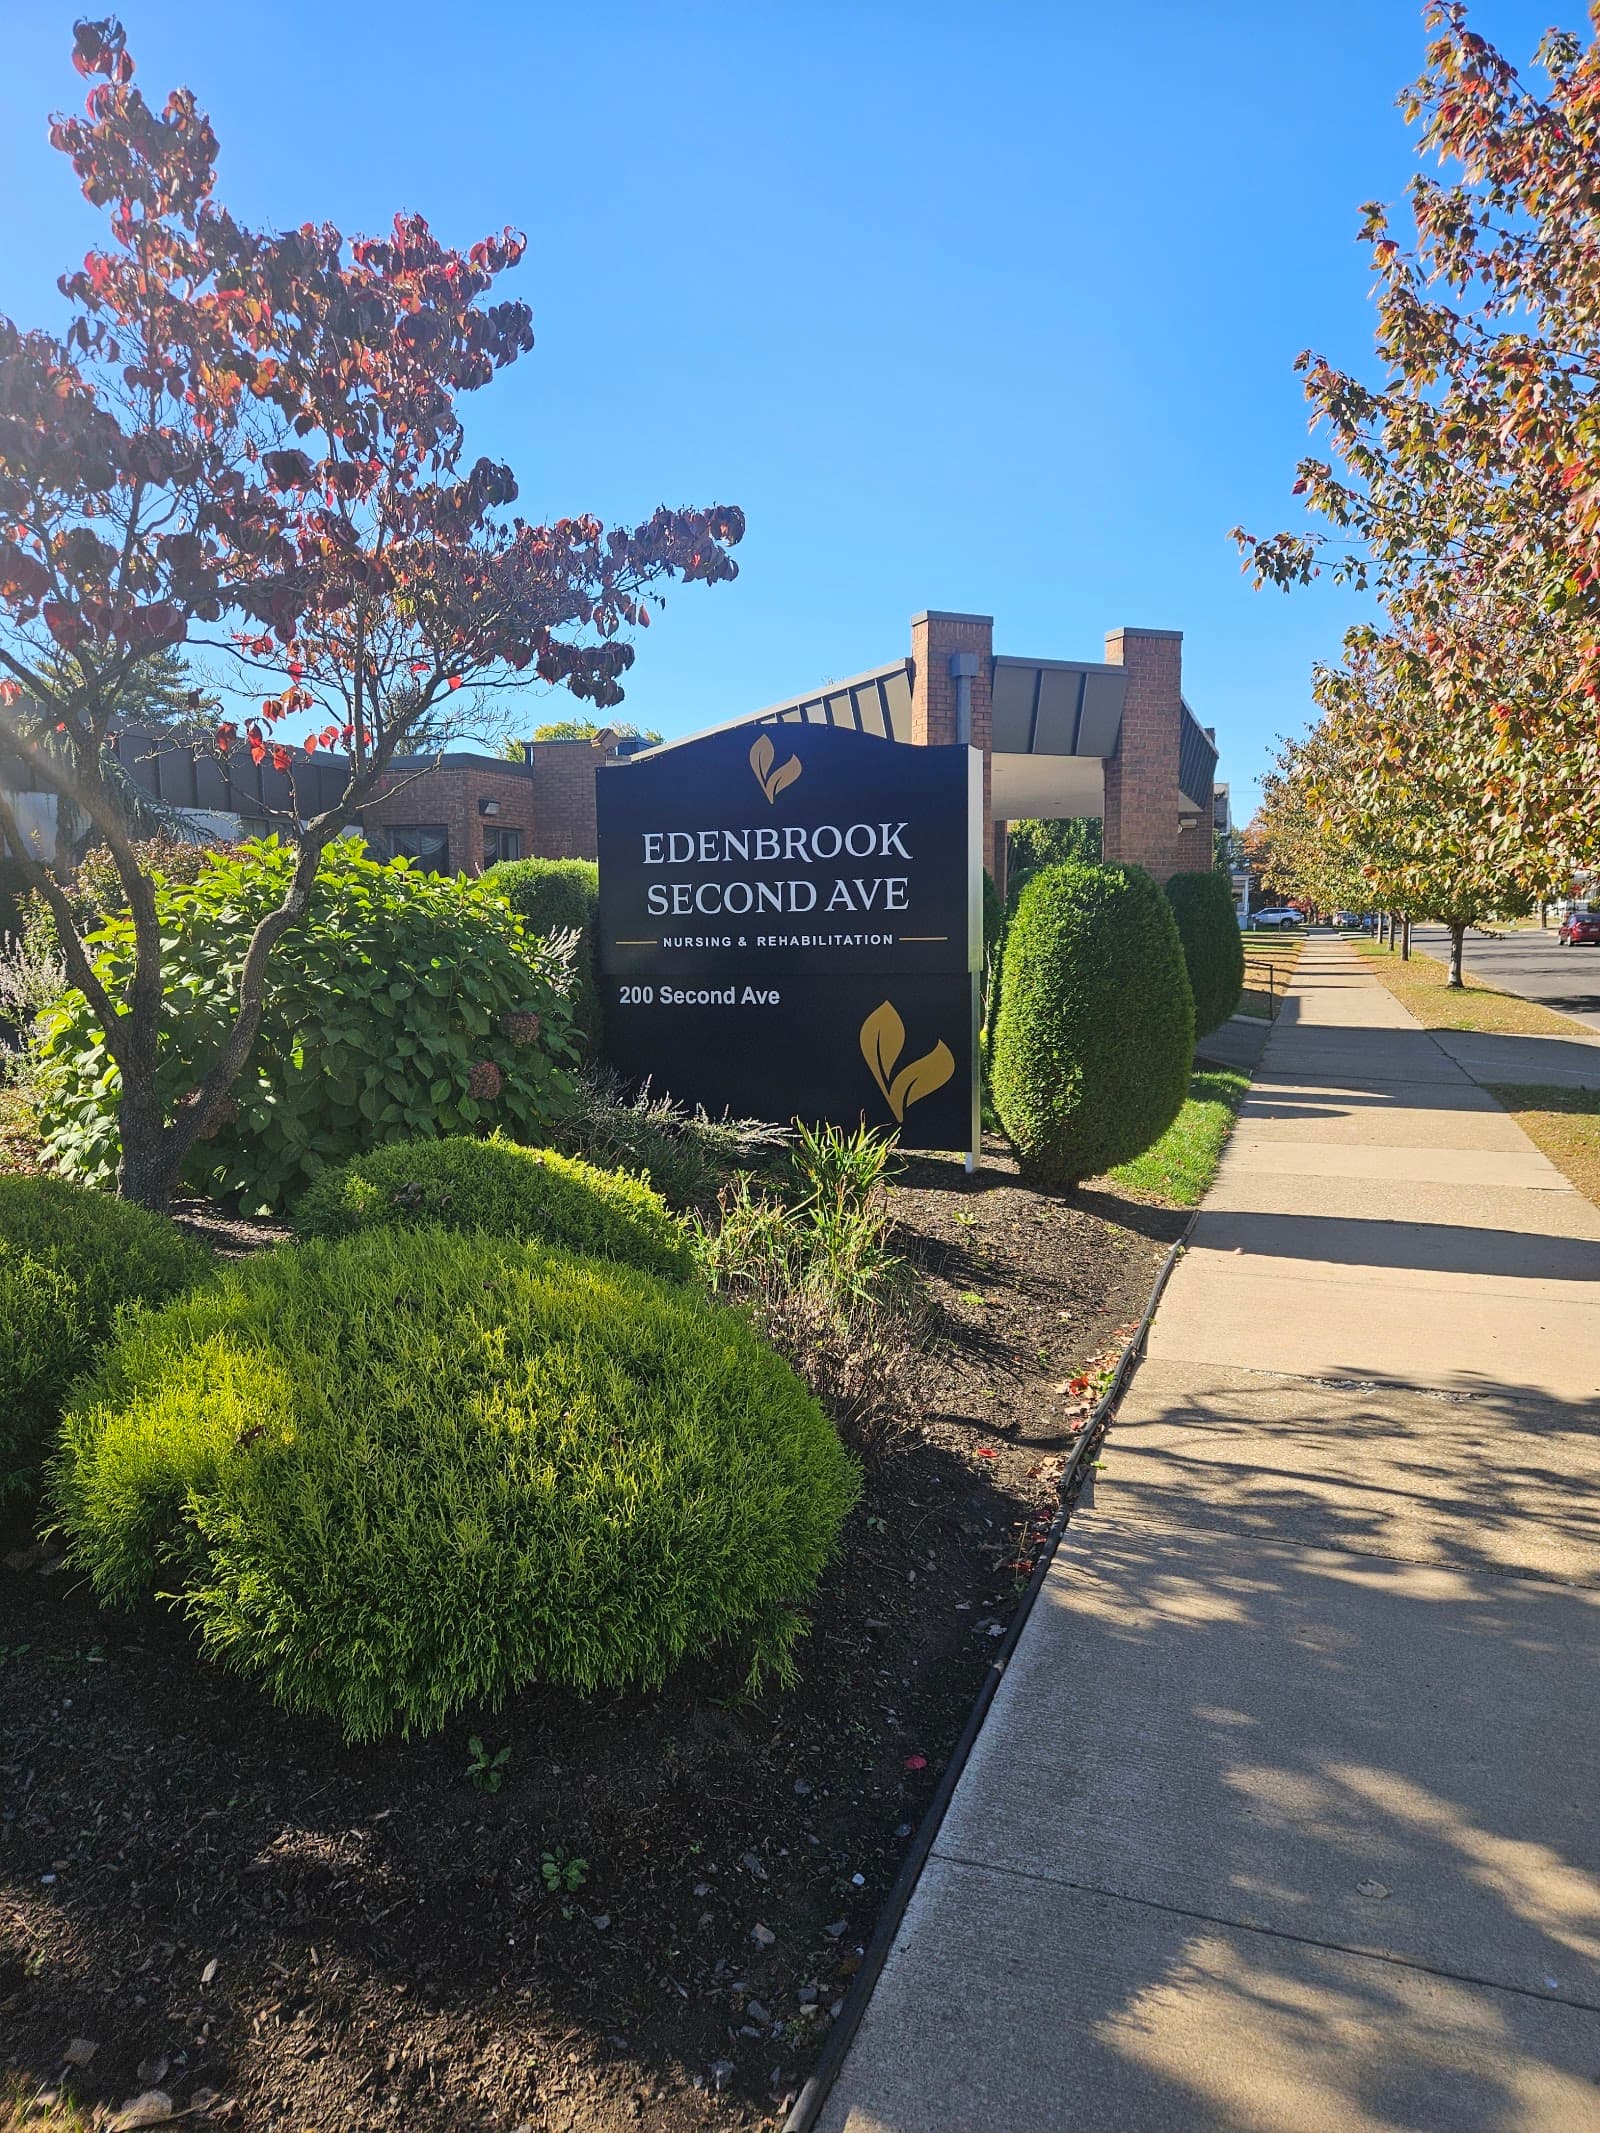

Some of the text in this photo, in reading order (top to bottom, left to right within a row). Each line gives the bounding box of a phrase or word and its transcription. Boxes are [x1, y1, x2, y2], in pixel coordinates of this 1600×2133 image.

[642, 822, 913, 864] EDENBROOK
[647, 877, 910, 915] SECOND AVE
[663, 934, 893, 948] NURSING & REHABILITATION
[619, 985, 780, 1005] 200 Second Ave
